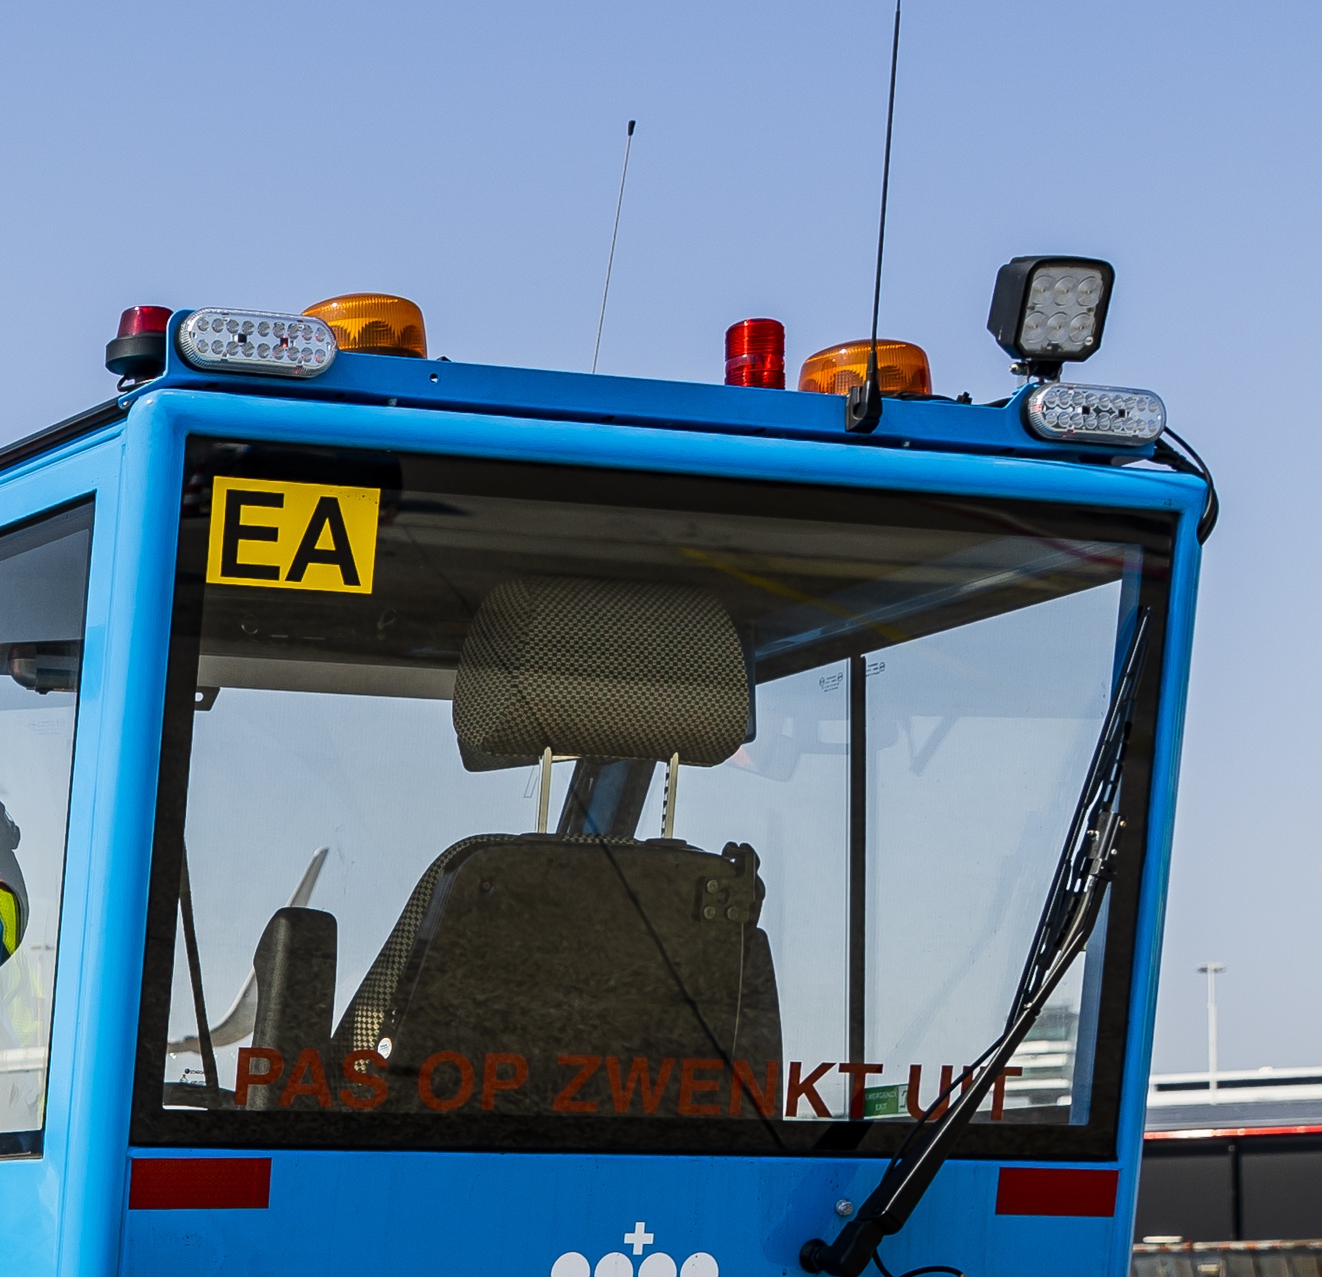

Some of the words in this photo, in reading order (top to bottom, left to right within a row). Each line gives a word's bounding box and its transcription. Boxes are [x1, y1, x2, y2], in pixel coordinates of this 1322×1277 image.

[220, 488, 362, 587] EA
[234, 1047, 388, 1110] PAS
[417, 1050, 529, 1111] OP
[552, 1054, 884, 1119] ZWENKT
